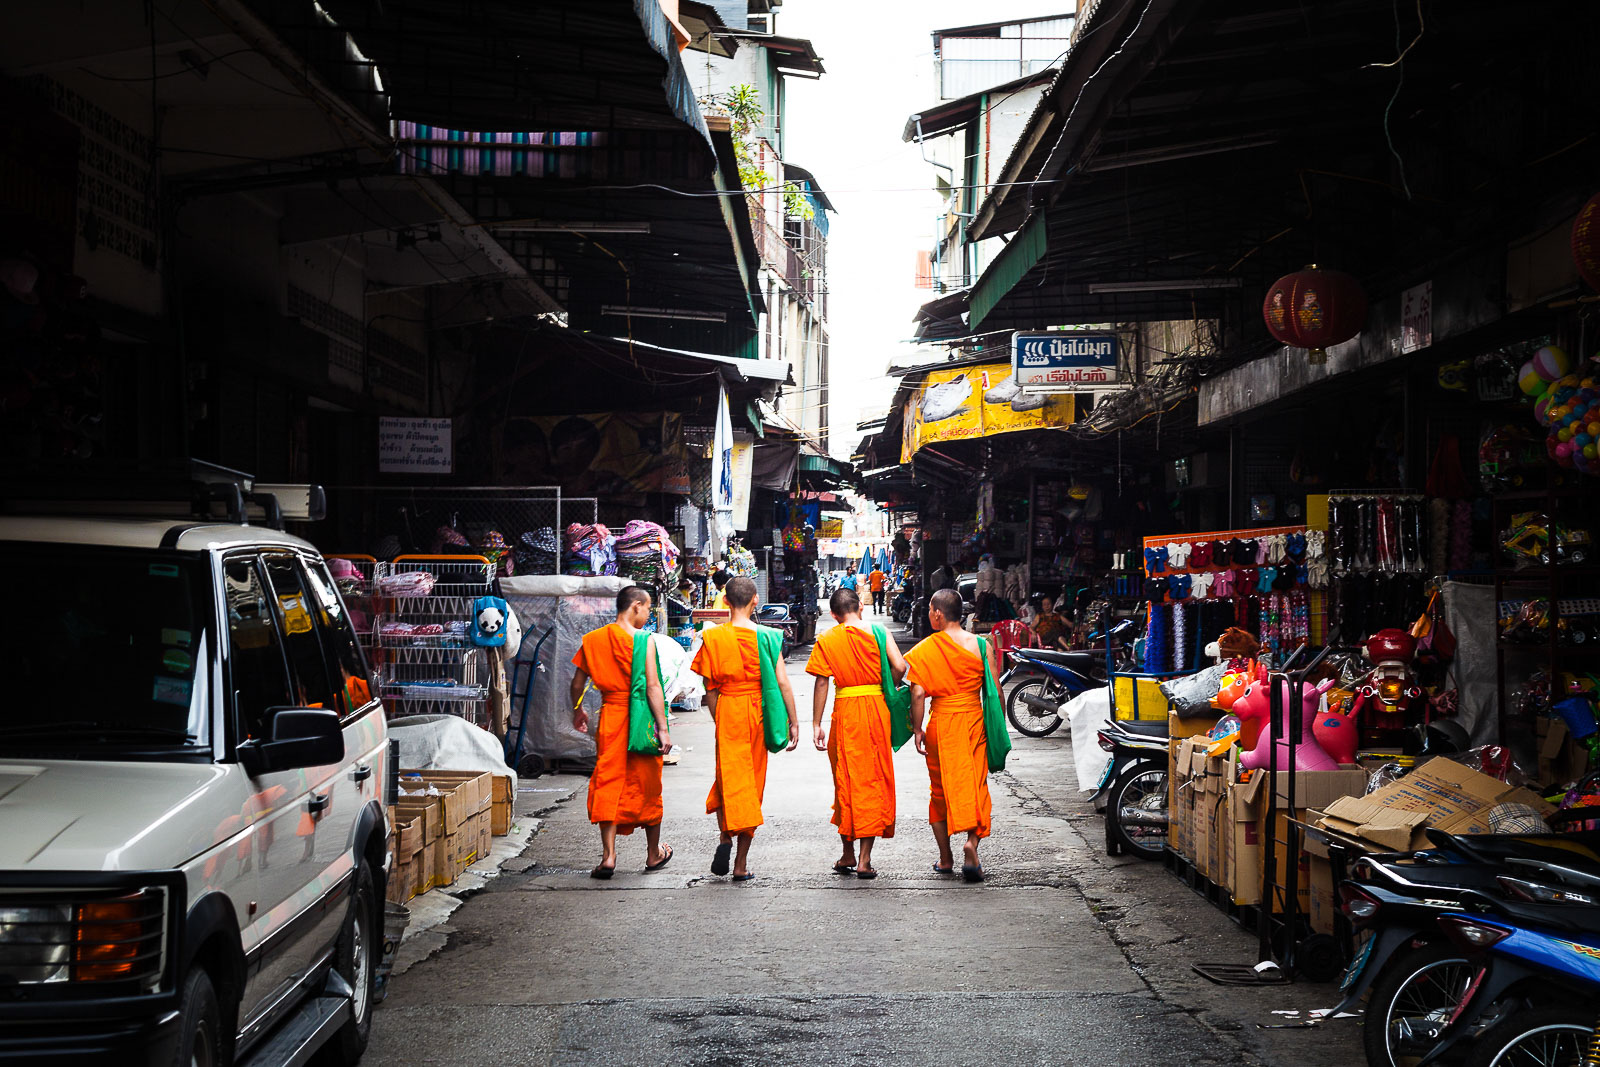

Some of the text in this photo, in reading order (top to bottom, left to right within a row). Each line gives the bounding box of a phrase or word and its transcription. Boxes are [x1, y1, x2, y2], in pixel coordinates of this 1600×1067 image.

[1049, 339, 1112, 362] ปุ๋ยไข่มุก
[1046, 368, 1107, 382] เรือใบไวกิ้ง
[1414, 781, 1433, 791] TOYS
[1432, 789, 1463, 803] VICTORY
